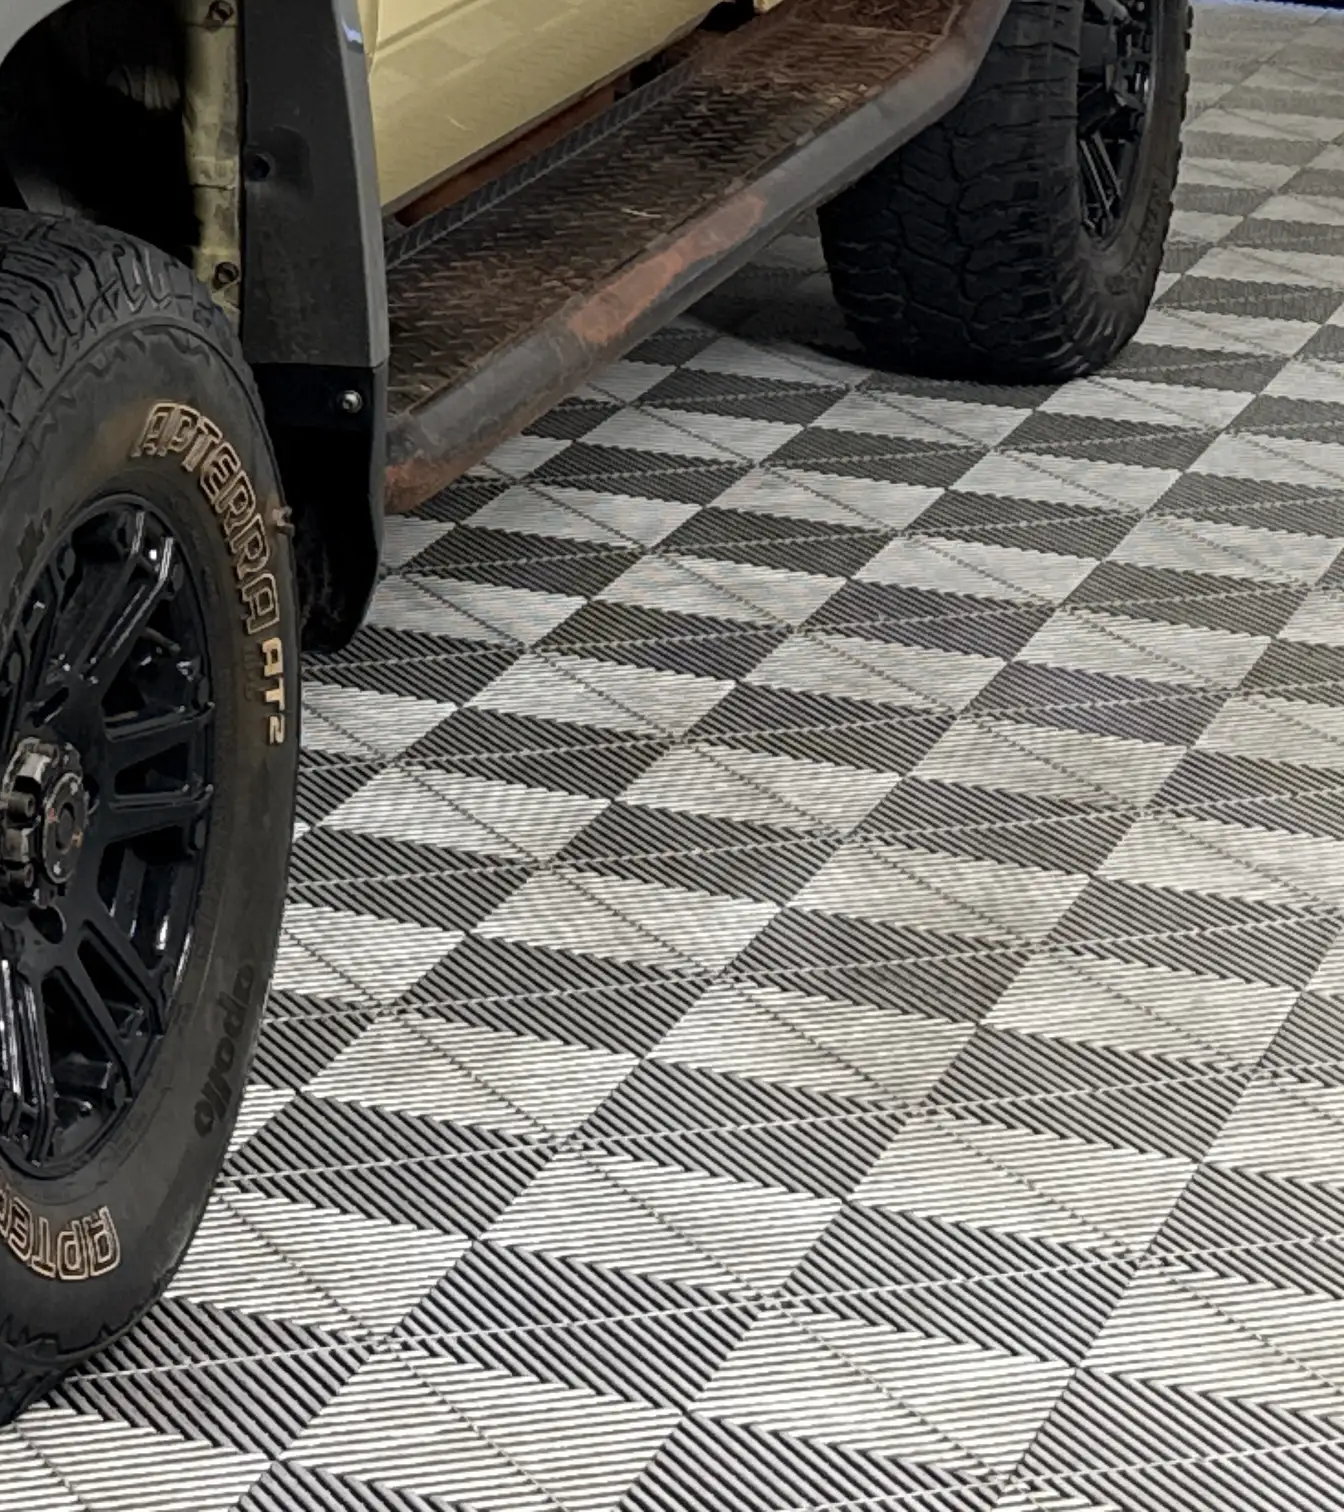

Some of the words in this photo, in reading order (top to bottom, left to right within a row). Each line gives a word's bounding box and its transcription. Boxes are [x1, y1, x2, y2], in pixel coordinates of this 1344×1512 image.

[130, 401, 281, 635] APTERRA
[261, 637, 286, 745] AT2
[194, 964, 255, 1137] apollo
